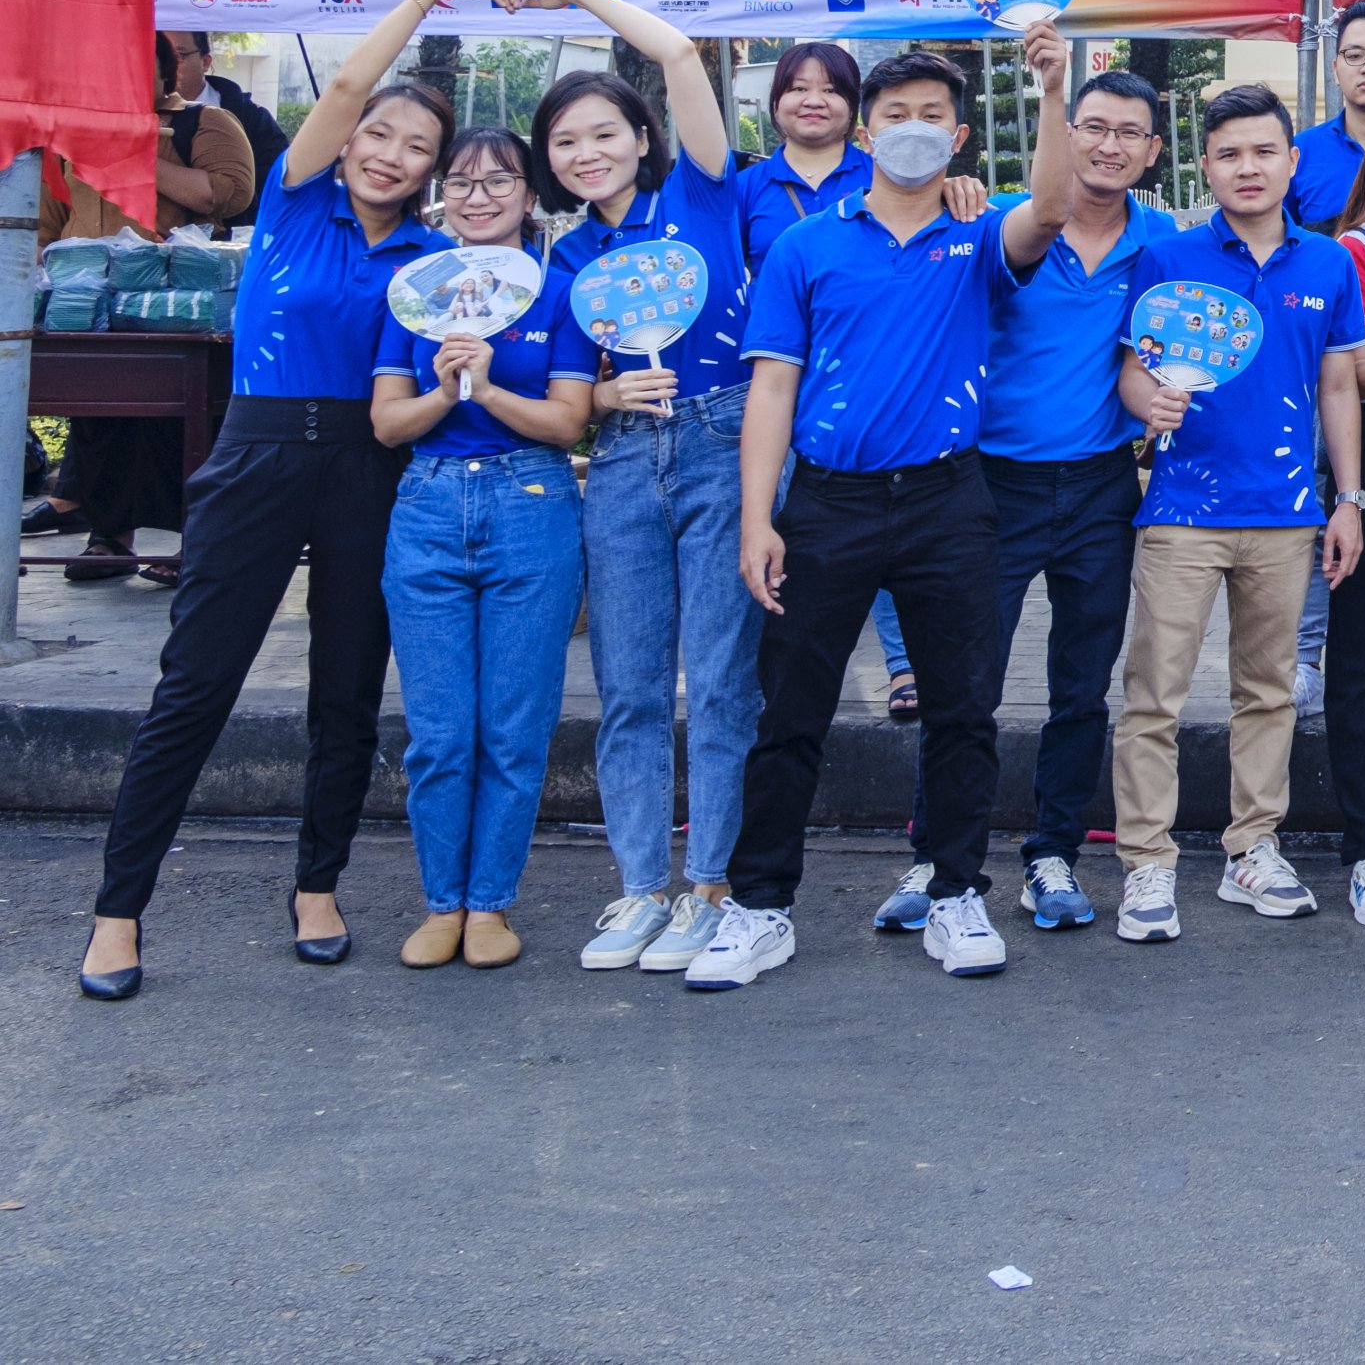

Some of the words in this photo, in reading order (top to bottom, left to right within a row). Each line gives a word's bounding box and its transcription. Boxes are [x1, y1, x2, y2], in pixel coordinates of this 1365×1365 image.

[318, 6, 366, 14] ENGLISH
[744, 1, 794, 13] BIMICO
[949, 243, 974, 257] MB
[1302, 296, 1325, 311] MB
[525, 331, 549, 343] MB
